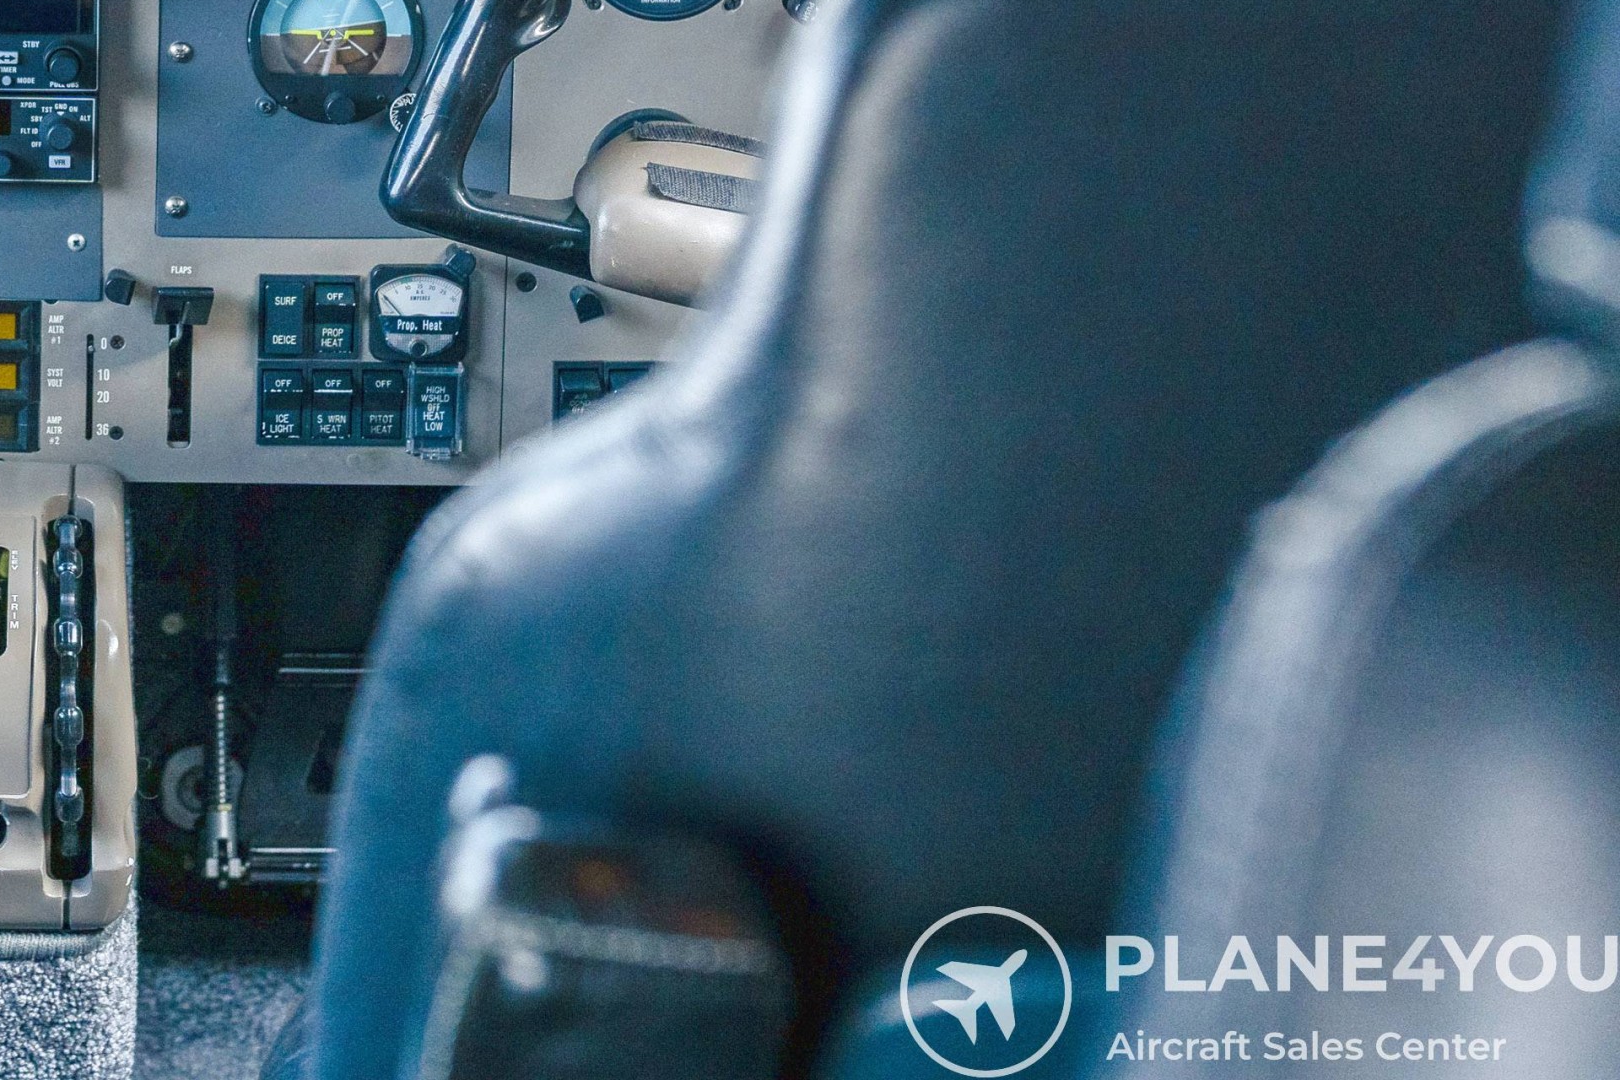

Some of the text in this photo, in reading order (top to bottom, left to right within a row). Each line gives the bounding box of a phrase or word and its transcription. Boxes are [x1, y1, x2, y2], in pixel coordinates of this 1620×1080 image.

[171, 266, 192, 274] FLAPS
[275, 296, 297, 306] SURF
[327, 292, 344, 301] OFF
[397, 319, 443, 332] Prop. Heat
[322, 327, 344, 337] PROP
[101, 338, 108, 350] 0
[273, 335, 297, 345] DEICE
[321, 336, 343, 346] HEAT
[98, 369, 110, 381] 10
[275, 379, 292, 388] OFF
[325, 379, 342, 388] OFF
[375, 380, 392, 388] OFF
[426, 386, 446, 394] HIGH
[96, 391, 109, 403] 20
[421, 394, 450, 402] WSHLD
[275, 413, 289, 423] ICE
[423, 411, 445, 420] HEAT
[96, 424, 109, 436] 36
[270, 423, 294, 434] LIGHT
[425, 421, 443, 431] LOW
